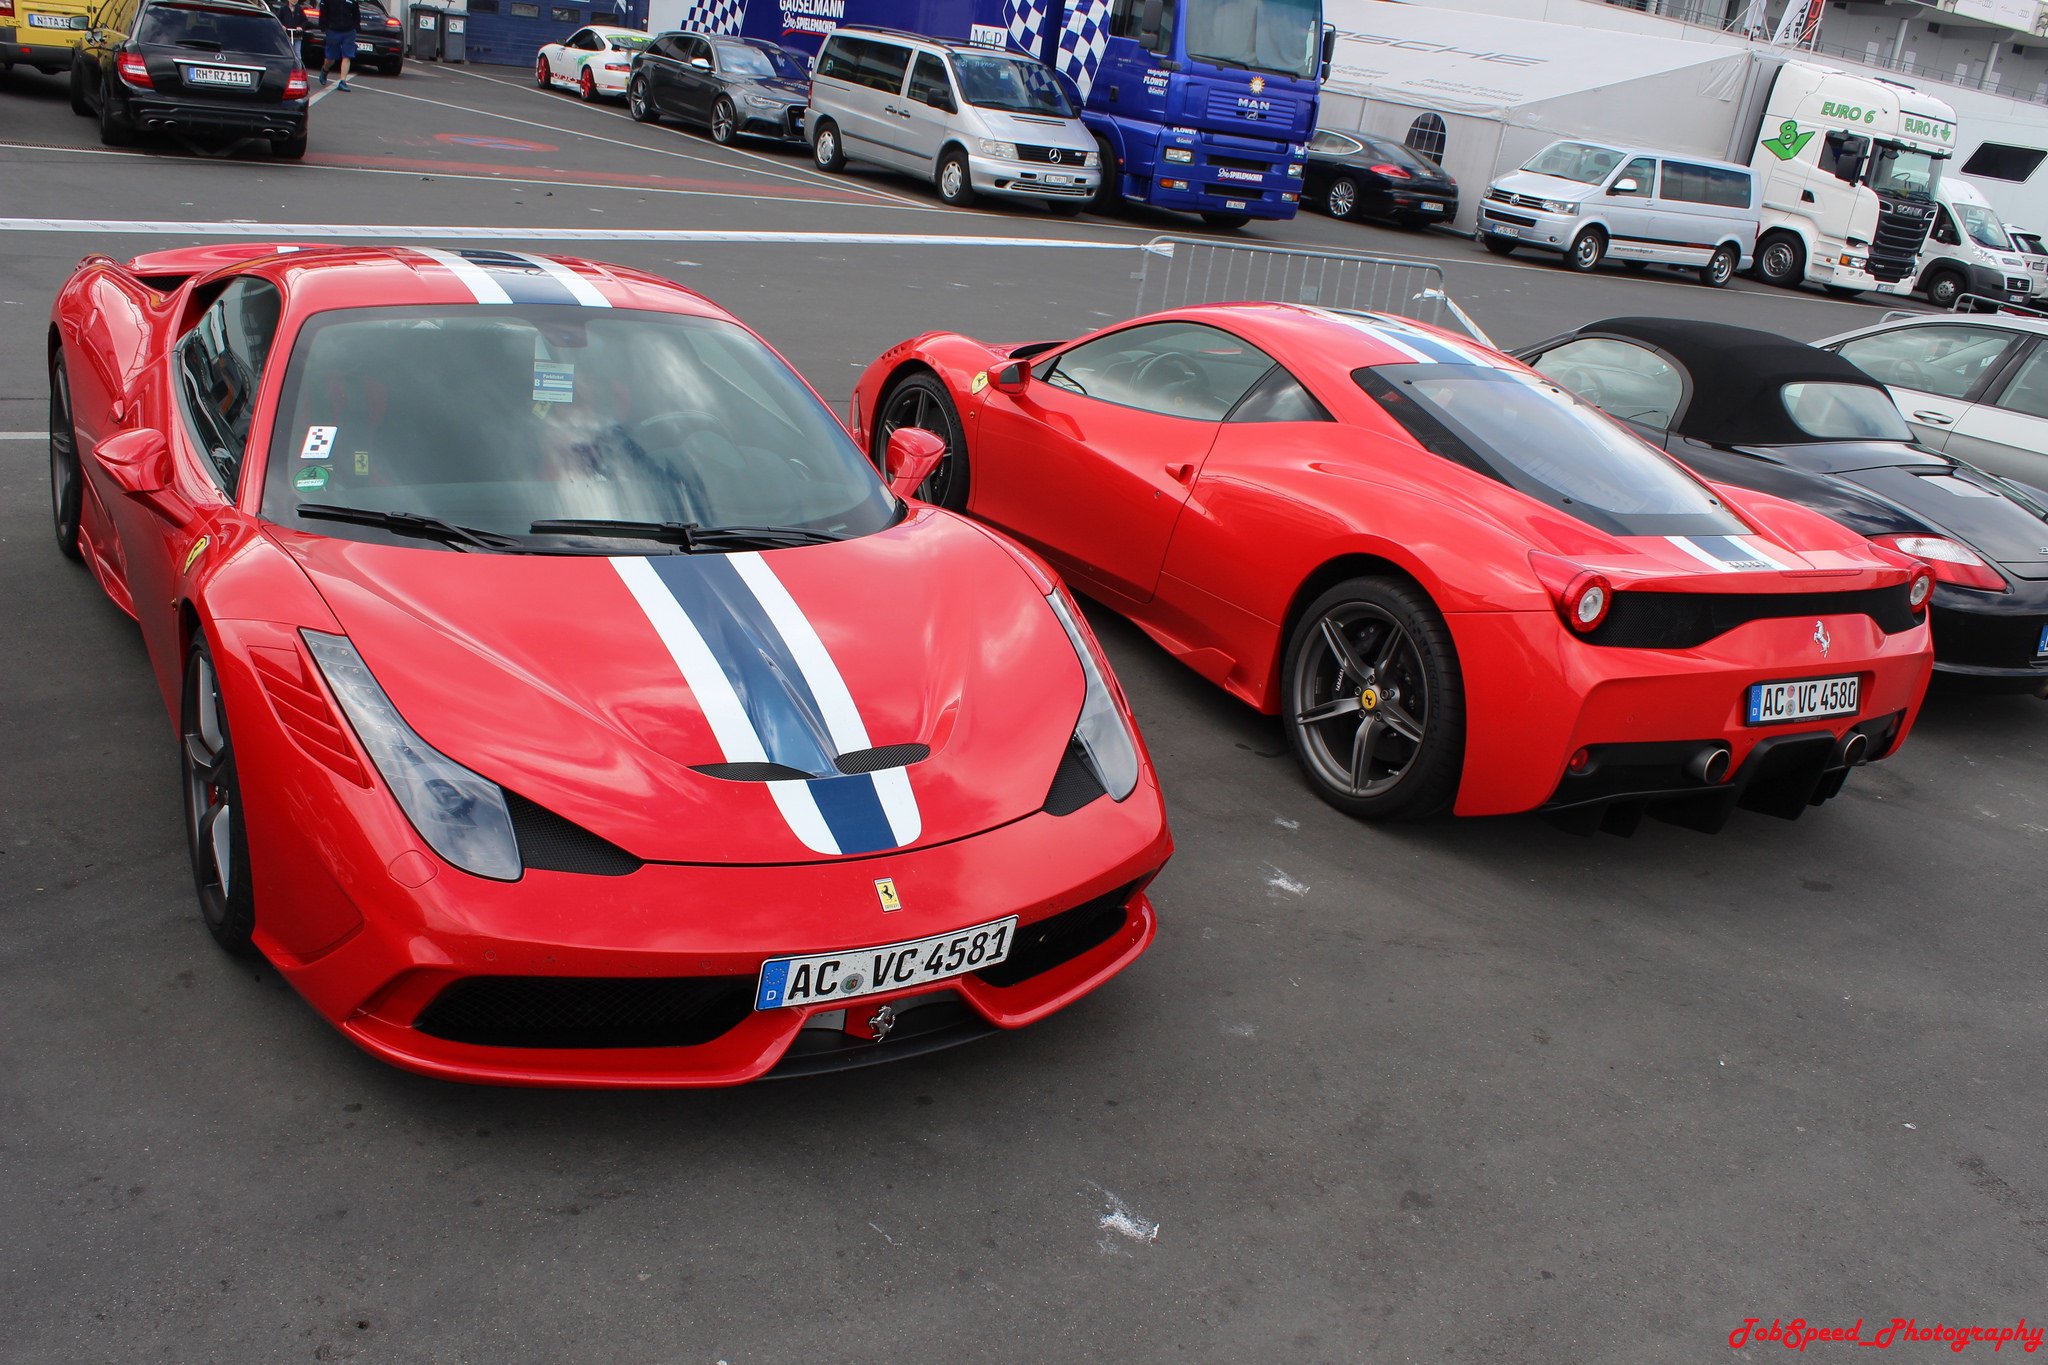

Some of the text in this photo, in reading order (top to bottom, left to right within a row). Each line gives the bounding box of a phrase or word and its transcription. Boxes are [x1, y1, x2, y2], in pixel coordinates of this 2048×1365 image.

[780, 0, 845, 18] GAUSELMANN
[195, 69, 250, 82] RH RZ 1111
[1143, 76, 1169, 87] FLOWEY
[1237, 97, 1270, 111] MAN
[1821, 102, 1876, 124] EURO 6
[1172, 127, 1197, 135] FLOWEY
[1904, 118, 1939, 138] EURO 6
[1896, 204, 1923, 217] SCANIA
[1763, 687, 1784, 717] AC
[1798, 684, 1817, 713] VC
[1821, 680, 1857, 711] 4580
[788, 961, 841, 1000] AC
[872, 948, 918, 989] VC
[924, 926, 1008, 975] 4581
